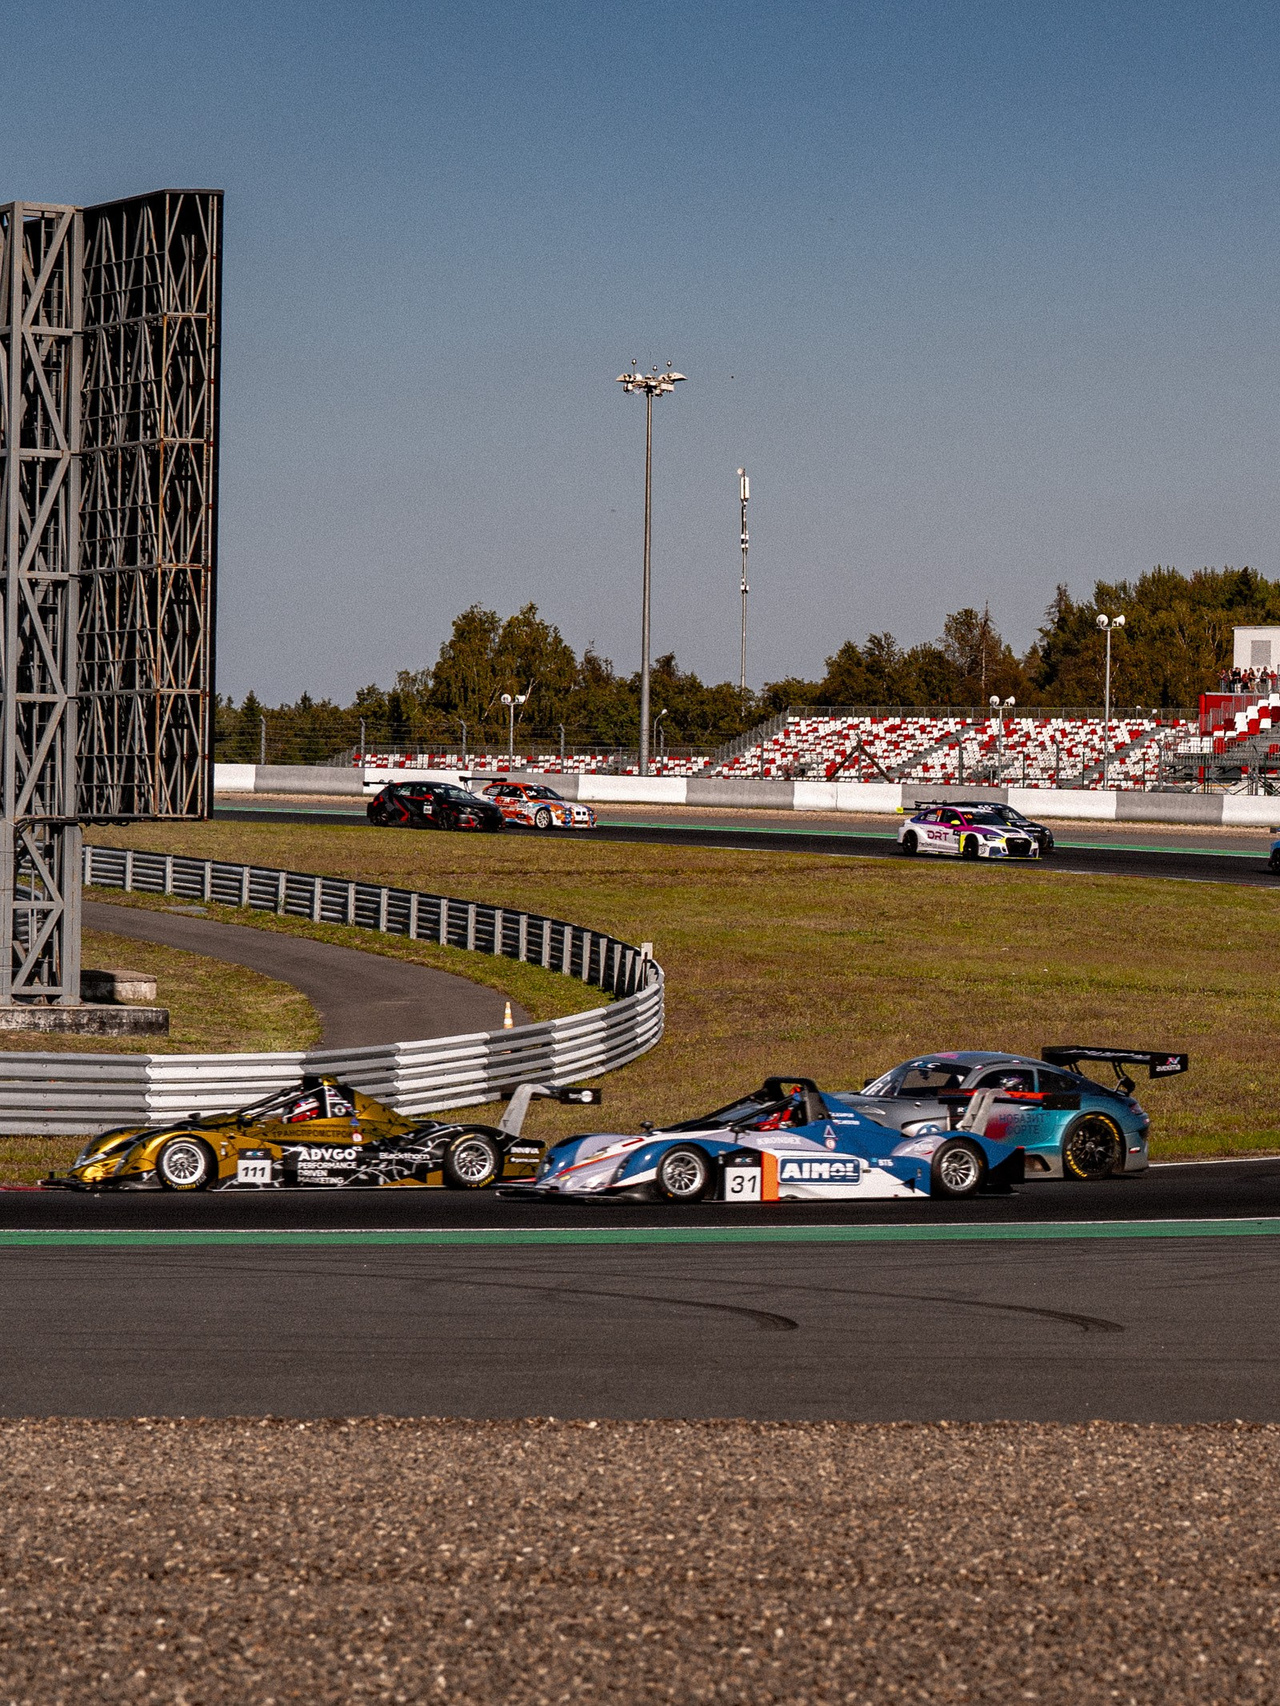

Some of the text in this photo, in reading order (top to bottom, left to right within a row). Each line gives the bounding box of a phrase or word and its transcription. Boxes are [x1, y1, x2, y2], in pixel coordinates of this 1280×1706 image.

[927, 830, 949, 841] DRT
[298, 1148, 357, 1161] ADVGO
[379, 1152, 430, 1160] Blackthorn
[297, 1161, 357, 1169] PERFORMANCE
[242, 1166, 266, 1178] 111
[297, 1169, 328, 1177] DRIVEN
[781, 1162, 859, 1180] AIMOL
[297, 1176, 344, 1184] MARKETING
[730, 1174, 758, 1194] 31
